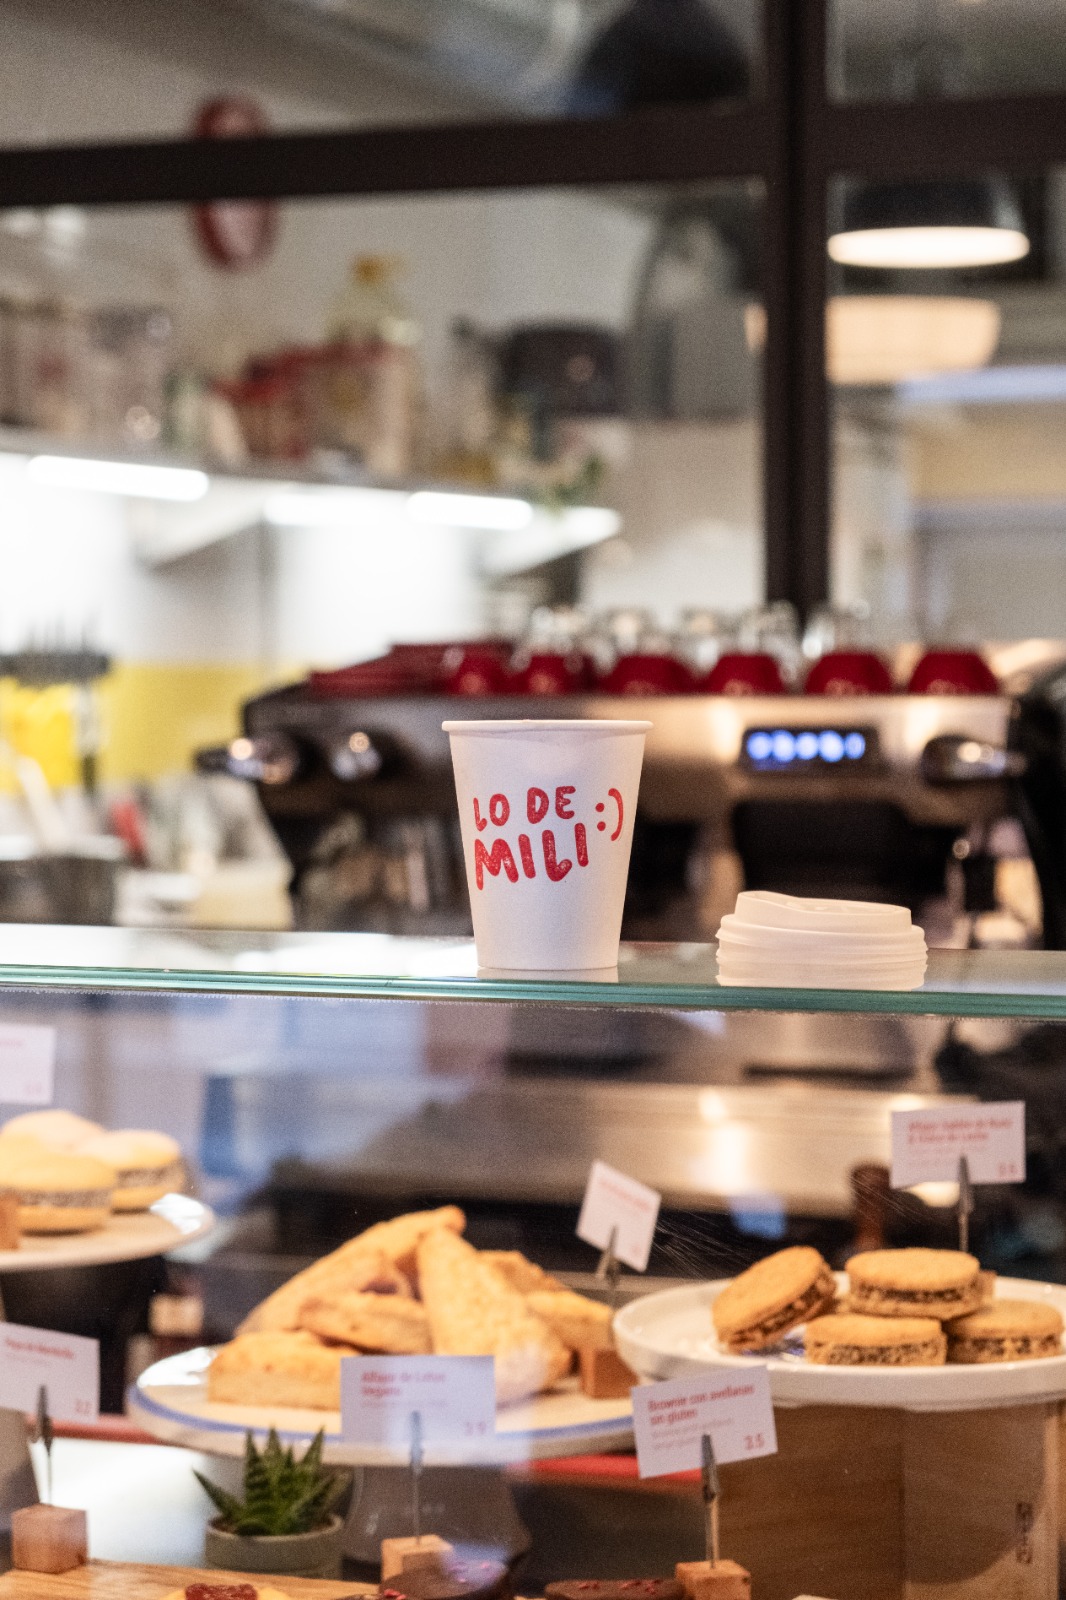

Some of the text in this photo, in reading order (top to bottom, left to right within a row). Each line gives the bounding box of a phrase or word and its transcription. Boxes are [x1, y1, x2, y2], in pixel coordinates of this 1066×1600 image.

[473, 786, 576, 831] LO DE
[474, 823, 589, 891] MILI
